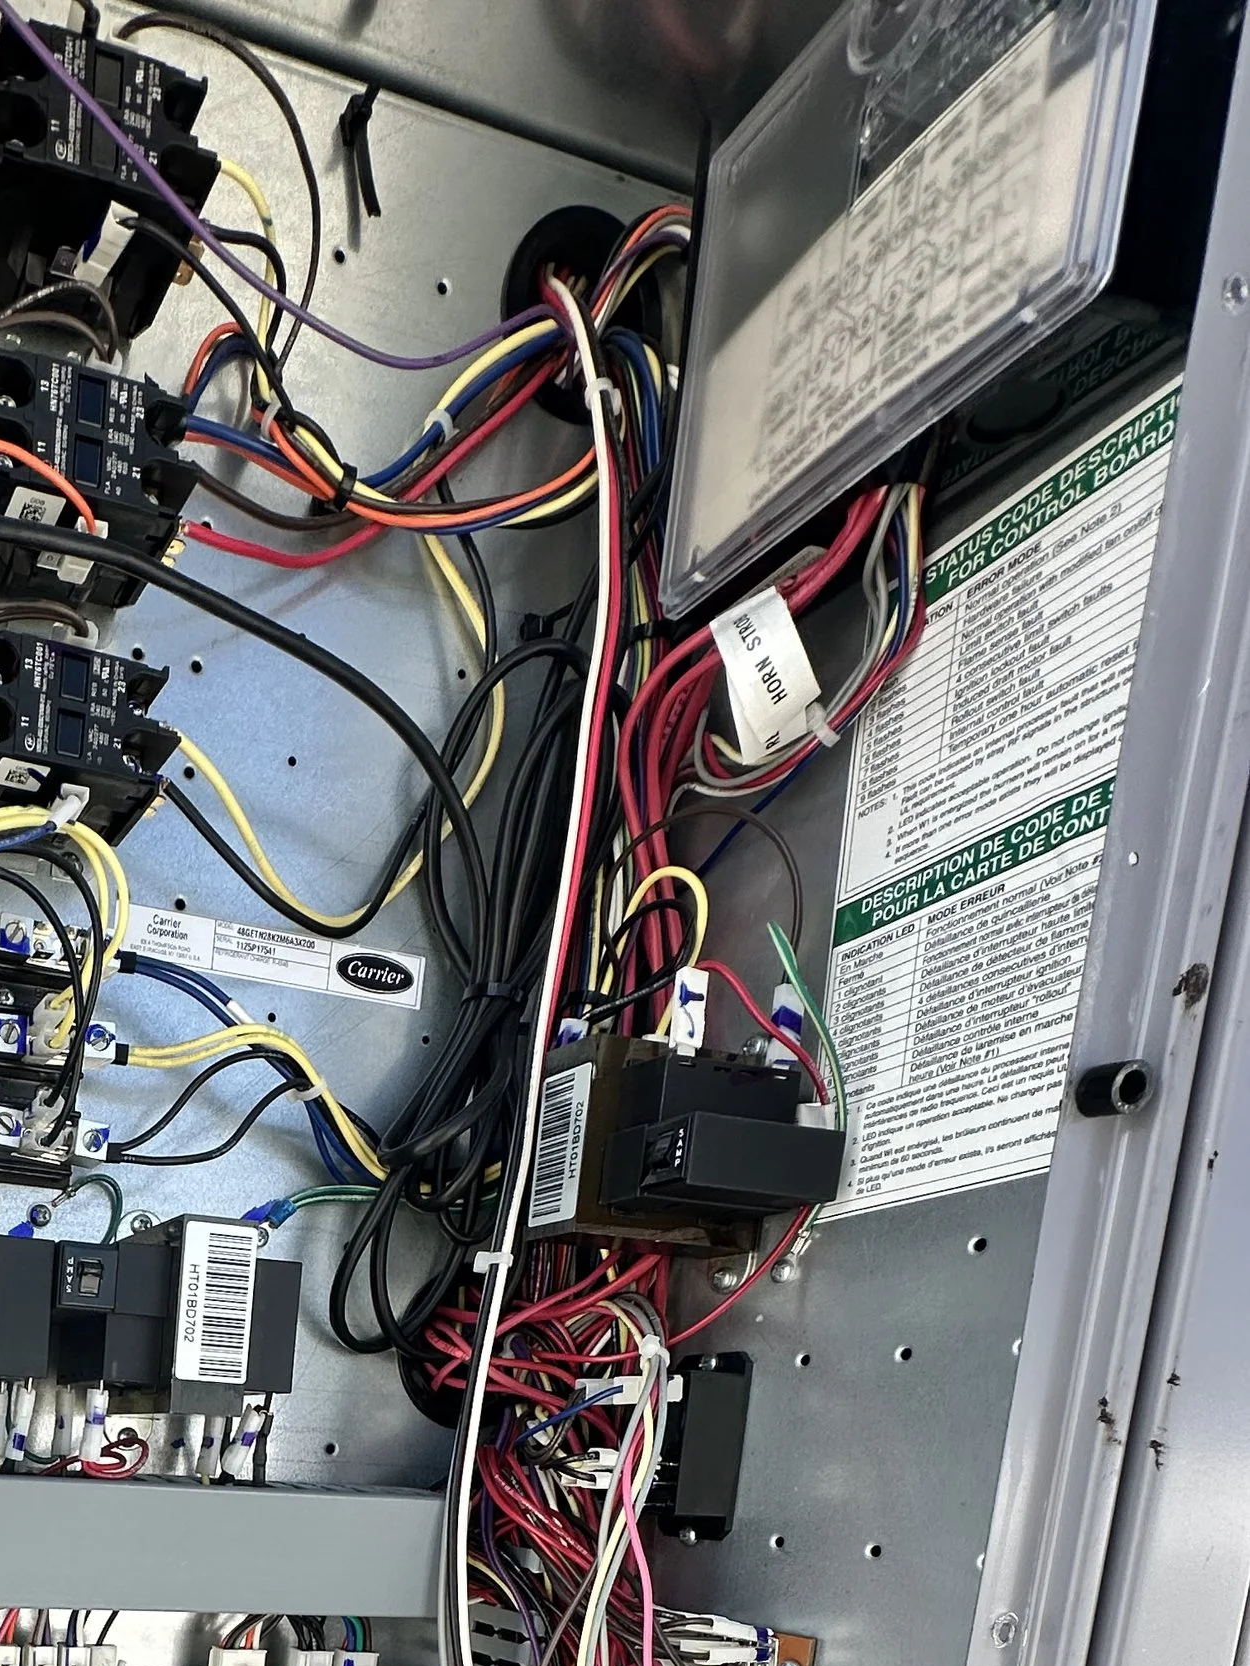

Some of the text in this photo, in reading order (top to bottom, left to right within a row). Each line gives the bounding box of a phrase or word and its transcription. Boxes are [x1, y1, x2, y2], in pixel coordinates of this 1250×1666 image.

[927, 527, 991, 582] STATUS
[998, 482, 1052, 531] CODE
[948, 421, 1173, 586] FOR CONTROL BOARD
[965, 503, 1121, 612] Normal operation (See Note 2)
[967, 541, 1040, 598] ERROR MODE
[959, 599, 1038, 655] Limit switch fault
[963, 593, 1008, 626] Hardware
[1012, 571, 1041, 594] failure
[956, 583, 1112, 682] 4 consecutive limit switch faults
[958, 611, 1042, 669] Flame sense fault
[25, 658, 34, 670] 13
[118, 681, 126, 694] 23
[755, 655, 788, 705] HORN
[953, 636, 1071, 711] Induced draft motor fault
[954, 634, 1049, 701] Ignition lockout fault
[949, 645, 1128, 753] Temporary one hour automatic reset
[951, 668, 1040, 725] Rollout switch fault
[113, 738, 122, 750] 21
[862, 788, 1101, 912] DESCRIPTION DE CODE DE
[872, 894, 917, 925] POUR
[923, 882, 944, 902] LA
[951, 850, 1011, 889] CARTE
[1019, 834, 1044, 859] DE
[926, 861, 1088, 937] Fonctionnement normal (Voir Note
[928, 884, 1004, 923] MODE ERREUR
[146, 924, 188, 940] Corporation
[152, 914, 182, 928] Carrier
[841, 924, 914, 960] INDICATION LED
[924, 894, 1049, 951] Défaillance de quincaillerie
[347, 961, 405, 985] Carrier
[838, 971, 863, 986] Fermé
[840, 952, 882, 974] En Marche
[568, 1099, 584, 1180] HT01BD702
[183, 1262, 198, 1344] HT01BD702
